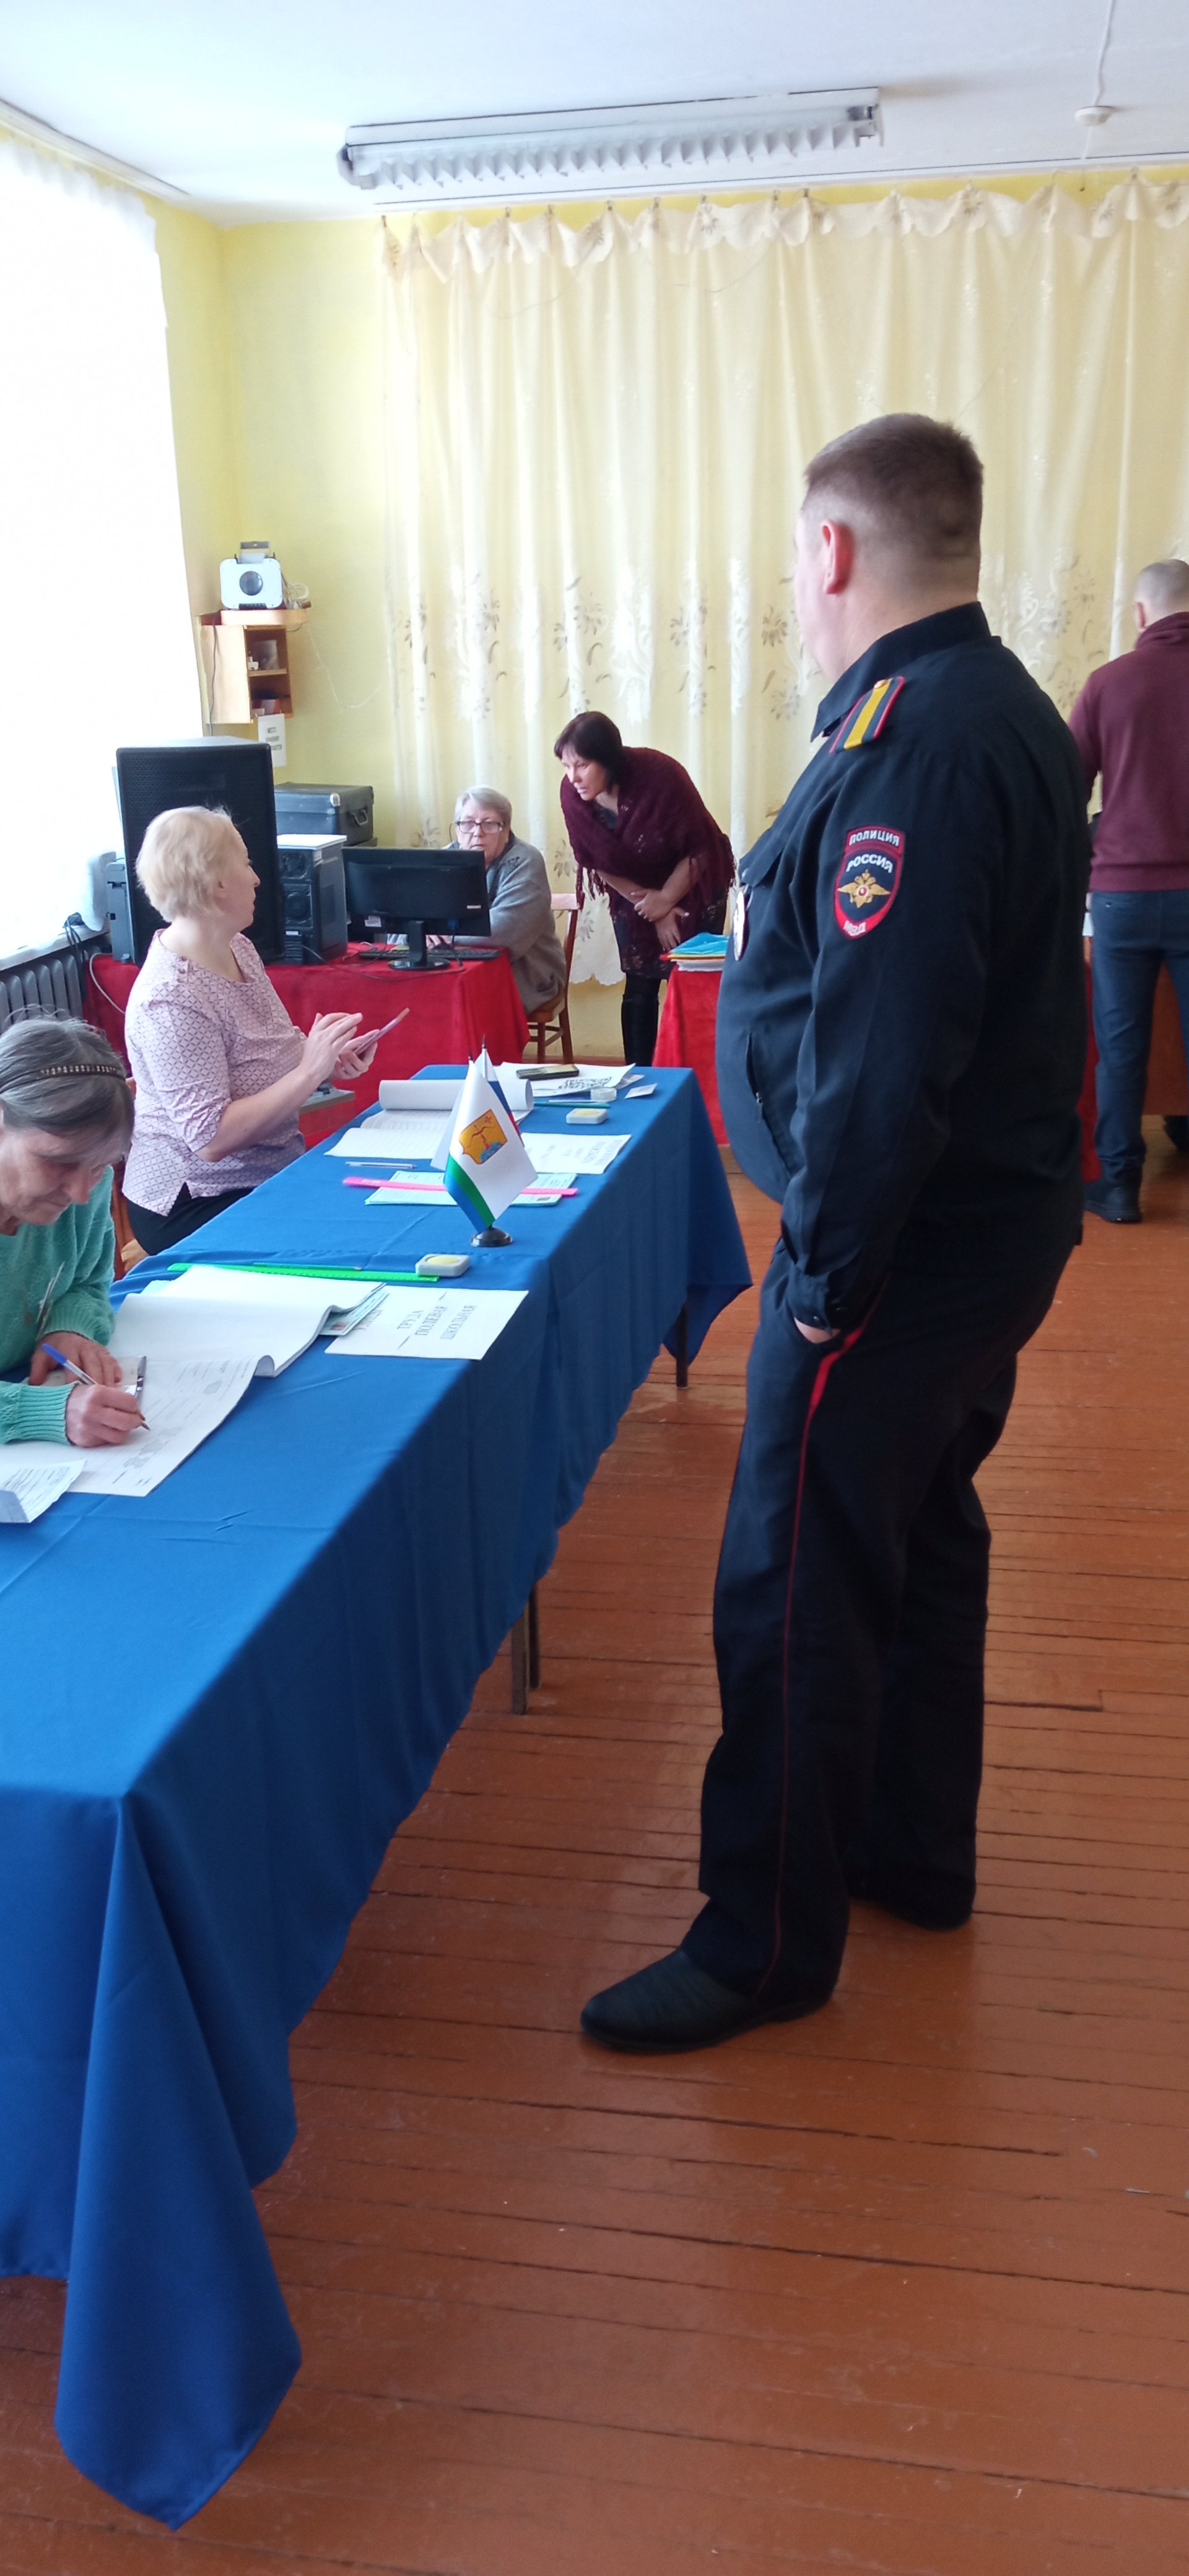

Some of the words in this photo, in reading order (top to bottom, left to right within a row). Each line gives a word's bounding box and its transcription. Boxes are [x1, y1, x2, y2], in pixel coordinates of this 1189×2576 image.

[848, 830, 900, 846] ПОЛИЦИЯ
[846, 854, 893, 873] РОССИЯ
[843, 920, 866, 936] МВД
[397, 1310, 424, 1329] ТРУДА
[414, 1306, 448, 1336] ПОЛЕВАЯ
[440, 1305, 477, 1339] ШКОЛЬНАЯ
